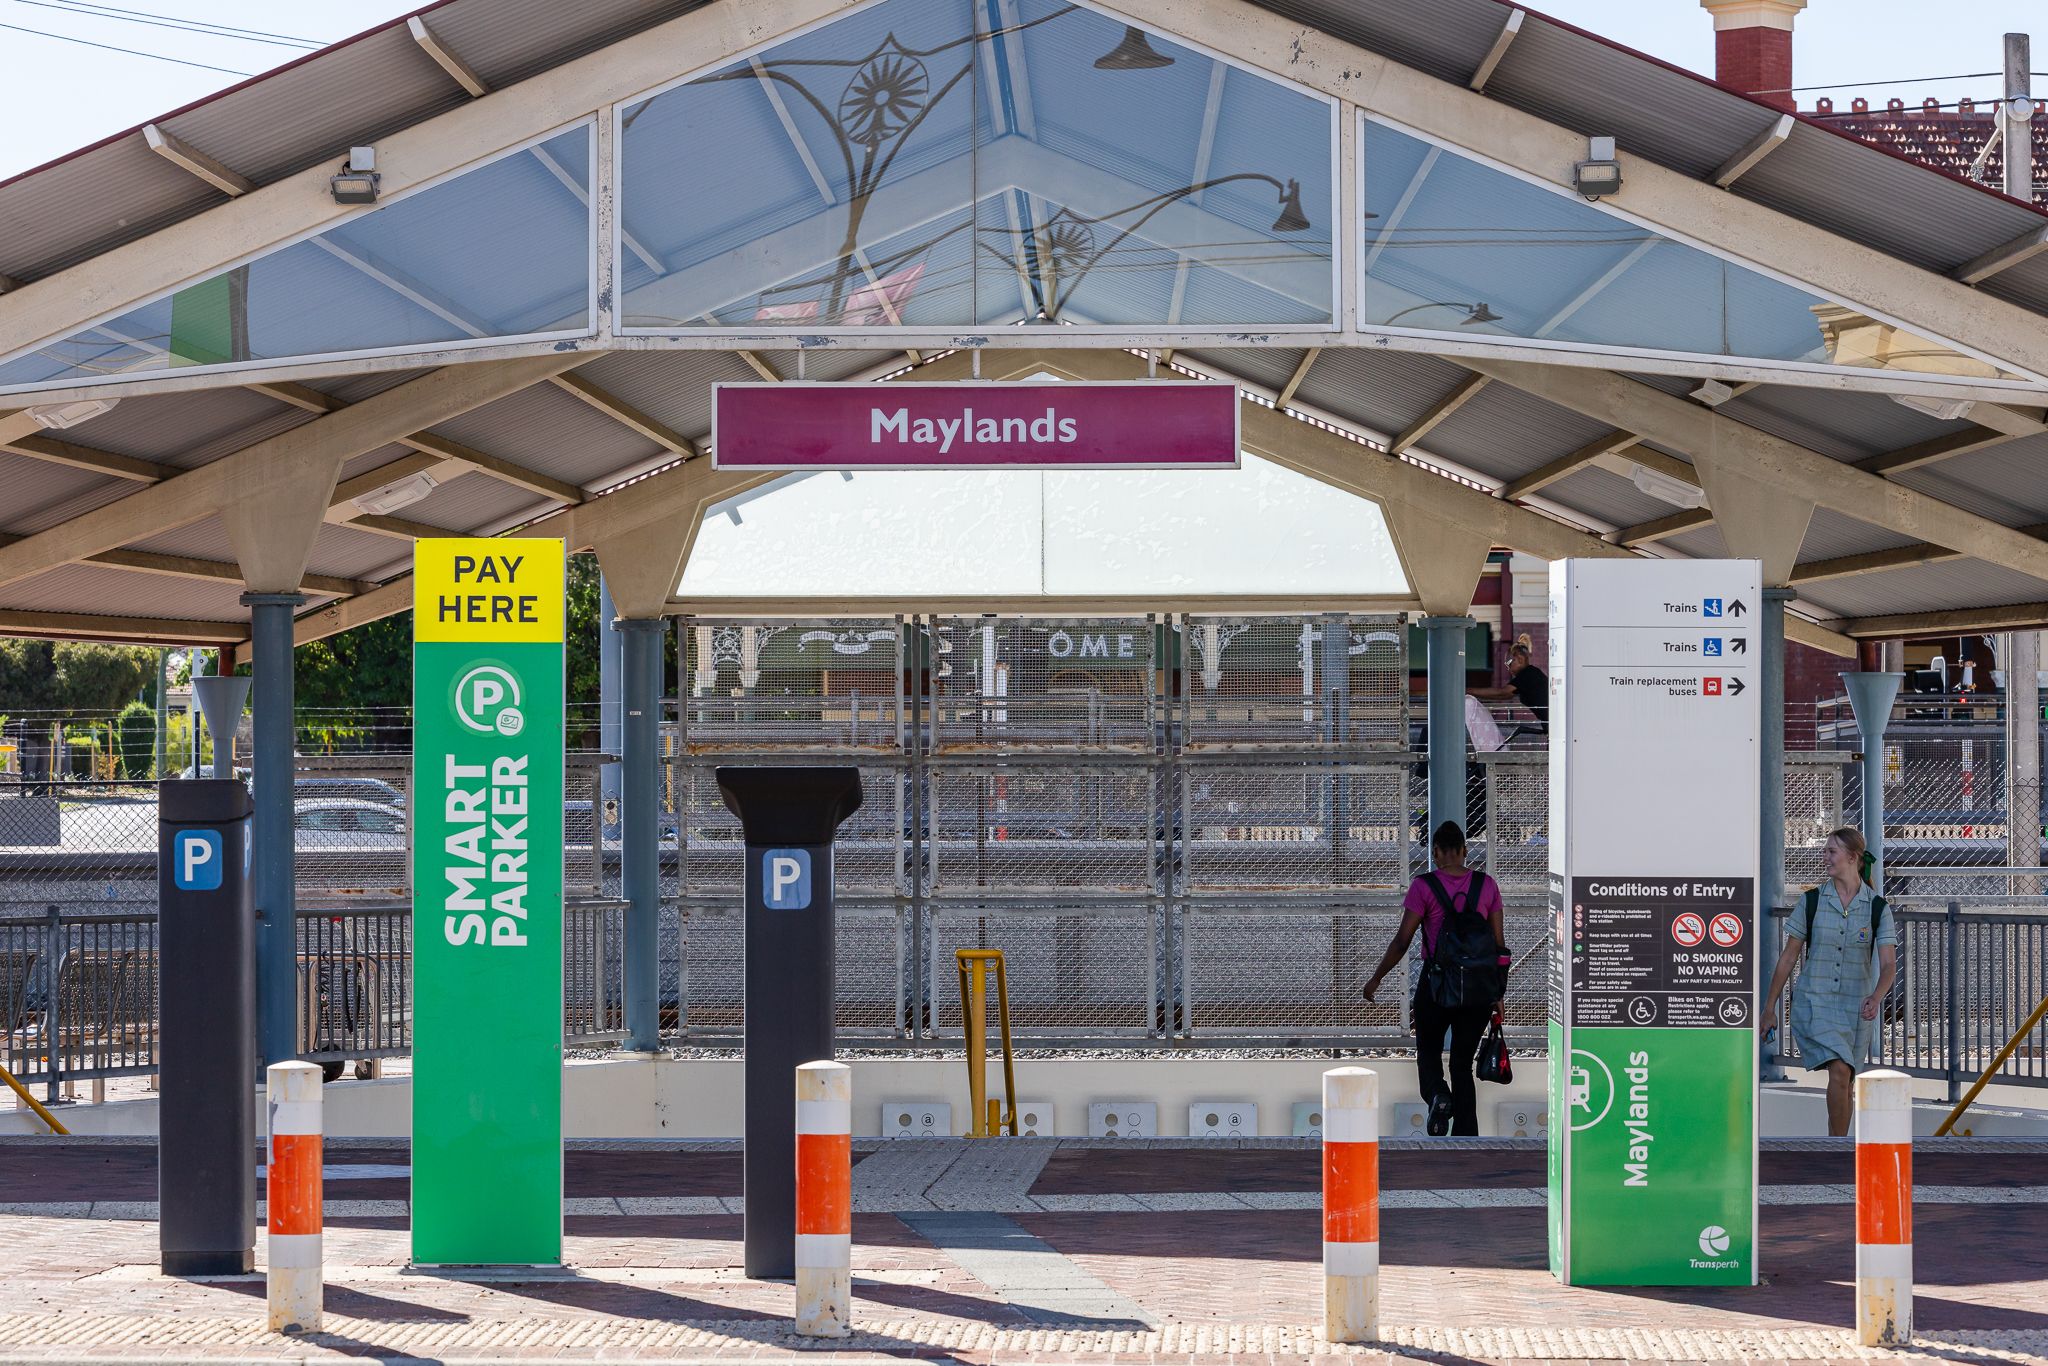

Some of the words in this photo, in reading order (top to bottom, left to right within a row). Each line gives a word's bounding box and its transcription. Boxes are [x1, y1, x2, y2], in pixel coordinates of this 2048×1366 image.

[871, 407, 1078, 454] Maylands
[454, 556, 524, 583] PAY
[439, 595, 538, 622] HERE
[1664, 603, 1697, 613] Trains
[1663, 642, 1697, 652] Trains
[1609, 677, 1634, 685] Train
[1637, 677, 1697, 687] replacement
[1669, 687, 1697, 696] buses
[473, 680, 504, 715] P
[184, 838, 212, 882] P
[244, 825, 250, 868] P
[444, 753, 486, 946] SMART
[491, 754, 528, 946] PARKER
[773, 857, 801, 901] P
[1589, 883, 1668, 896] Conditions
[1673, 883, 1688, 896] of
[1693, 884, 1735, 899] Entry
[1673, 954, 1689, 963] NO
[1693, 954, 1743, 963] SMOKING
[1678, 966, 1694, 975] NO
[1697, 966, 1738, 975] VAPING
[1623, 1050, 1654, 1186] Maylands
[1689, 1259, 1739, 1271] Transperth
